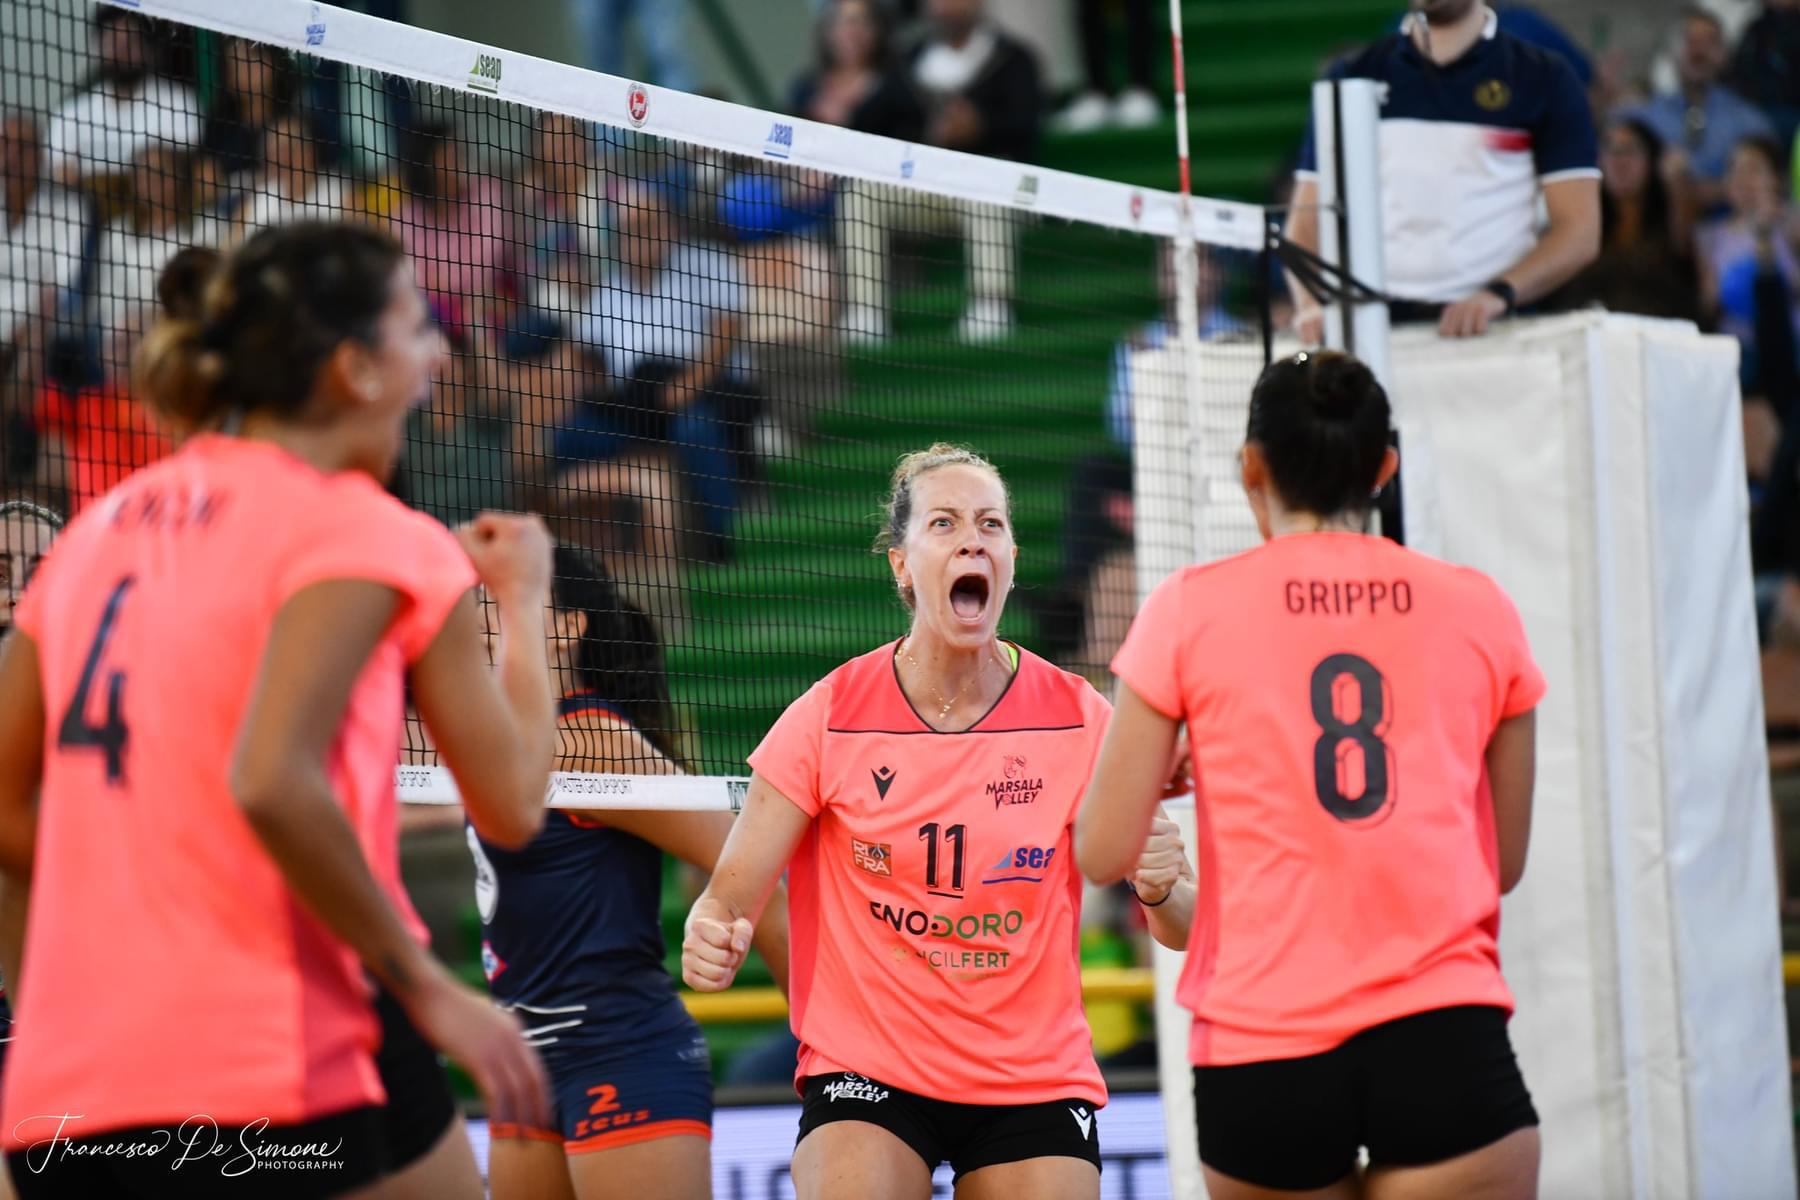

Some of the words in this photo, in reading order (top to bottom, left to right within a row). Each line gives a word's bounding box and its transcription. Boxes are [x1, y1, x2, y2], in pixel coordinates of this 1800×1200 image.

[480, 54, 502, 84] seap
[1285, 579, 1414, 616] GRIPPO
[57, 573, 137, 786] 4
[1309, 652, 1398, 831] 8
[986, 778, 1043, 796] MARSALA
[995, 791, 1039, 811] VOLLEY
[855, 854, 890, 875] FRA
[918, 822, 969, 892] 11
[586, 1083, 621, 1116] 2
[822, 1080, 890, 1099] MARSALA
[829, 1089, 884, 1103] VOLLEY
